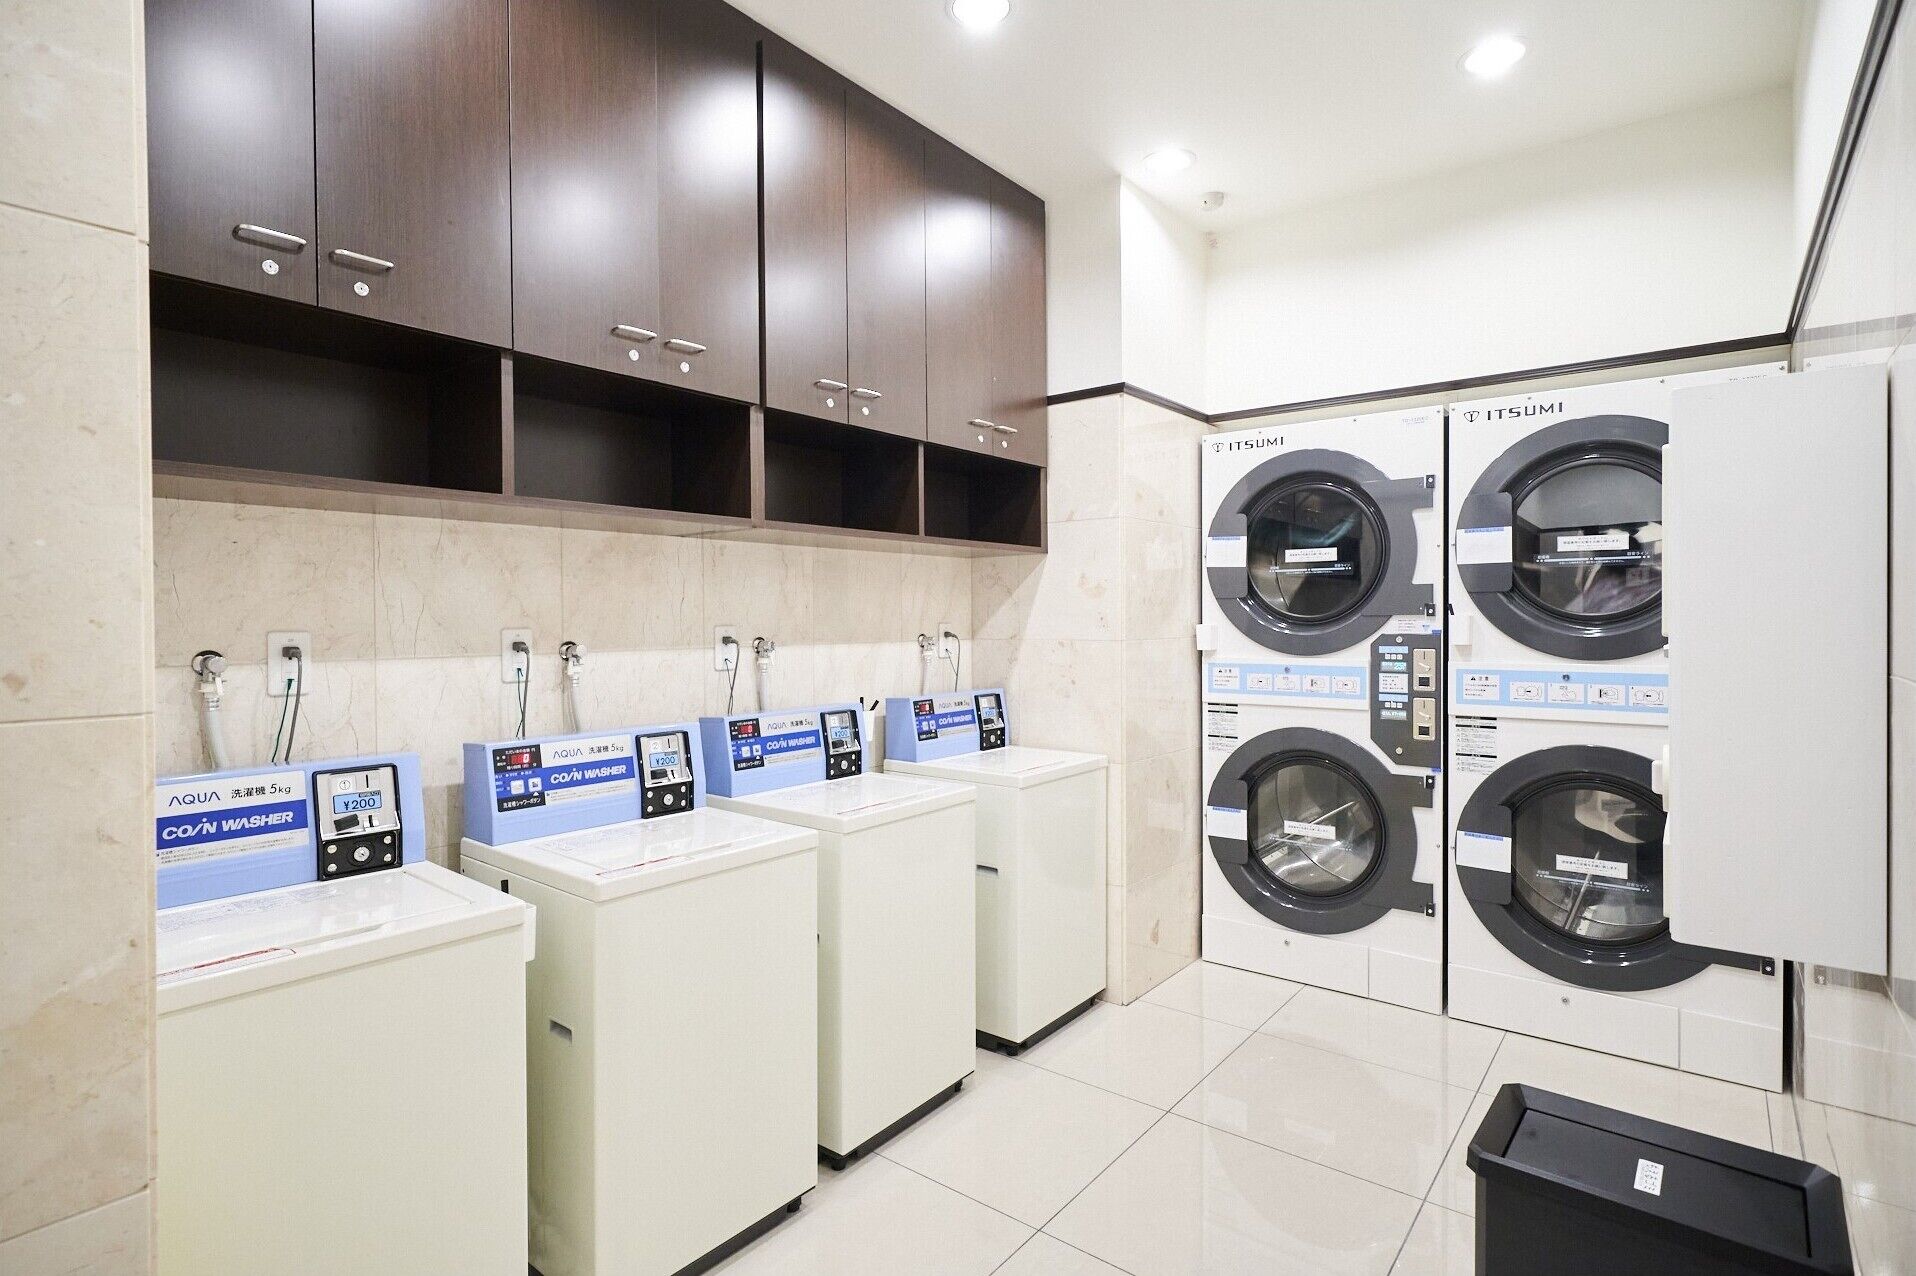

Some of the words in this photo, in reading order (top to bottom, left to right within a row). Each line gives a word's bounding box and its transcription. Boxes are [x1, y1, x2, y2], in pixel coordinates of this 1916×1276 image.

[1487, 402, 1563, 421] ITSUMI
[1229, 436, 1284, 451] ITSUMI
[552, 748, 583, 760] AQUA
[610, 743, 624, 752] 5kg
[766, 737, 787, 750] COIN
[655, 755, 676, 766] ¥200
[550, 767, 582, 784] COIN
[584, 764, 627, 779] WASHER
[168, 791, 221, 807] AQUA
[231, 785, 266, 799] 洗濯機
[269, 783, 292, 795] 5kg
[343, 797, 376, 811] ¥200
[161, 817, 217, 840] COIN
[221, 811, 294, 832] WASHER
